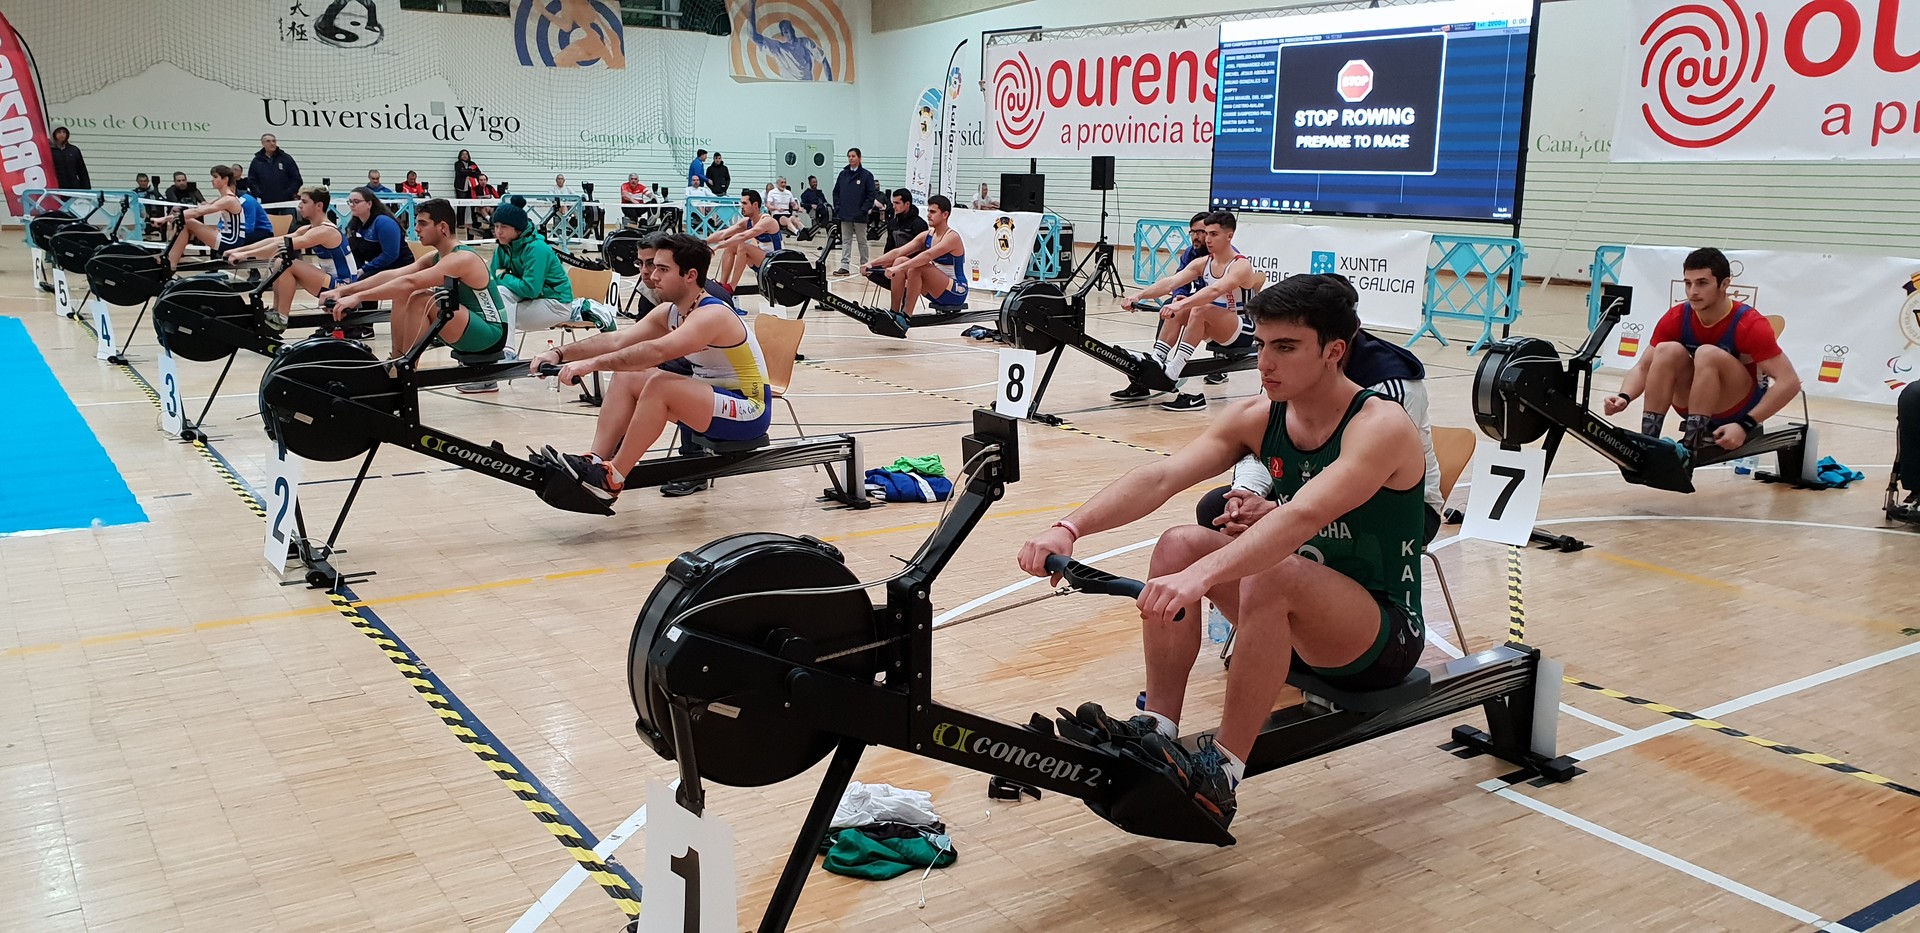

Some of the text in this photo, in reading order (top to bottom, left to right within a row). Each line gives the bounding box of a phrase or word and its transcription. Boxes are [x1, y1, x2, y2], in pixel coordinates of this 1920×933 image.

[1341, 75, 1369, 88] STOP
[102, 114, 126, 129] de
[132, 115, 211, 132] Ourense
[455, 106, 521, 142] Vigo
[1294, 107, 1416, 127] STOP ROWING
[580, 129, 712, 146] Campus de Ourense
[1061, 123, 1071, 144] a
[1077, 114, 1184, 150] provincia
[1295, 134, 1410, 148] PREPARE TO RACE
[1535, 132, 1612, 159] Campus
[35, 257, 40, 280] 6
[1247, 256, 1278, 269] ALICIA
[1339, 256, 1388, 273] XUNTA
[58, 280, 68, 307] 5
[1358, 276, 1415, 294] GALICIA
[101, 313, 111, 347] 4
[1096, 346, 1136, 371] concept 2
[165, 373, 177, 418] 3
[1005, 362, 1024, 403] 8
[1599, 430, 1640, 463] concept 2
[446, 445, 535, 481] concept 2
[1488, 464, 1526, 521] 7
[272, 476, 290, 545] 2
[972, 735, 1102, 788] concept 2
[670, 845, 701, 933] 1
